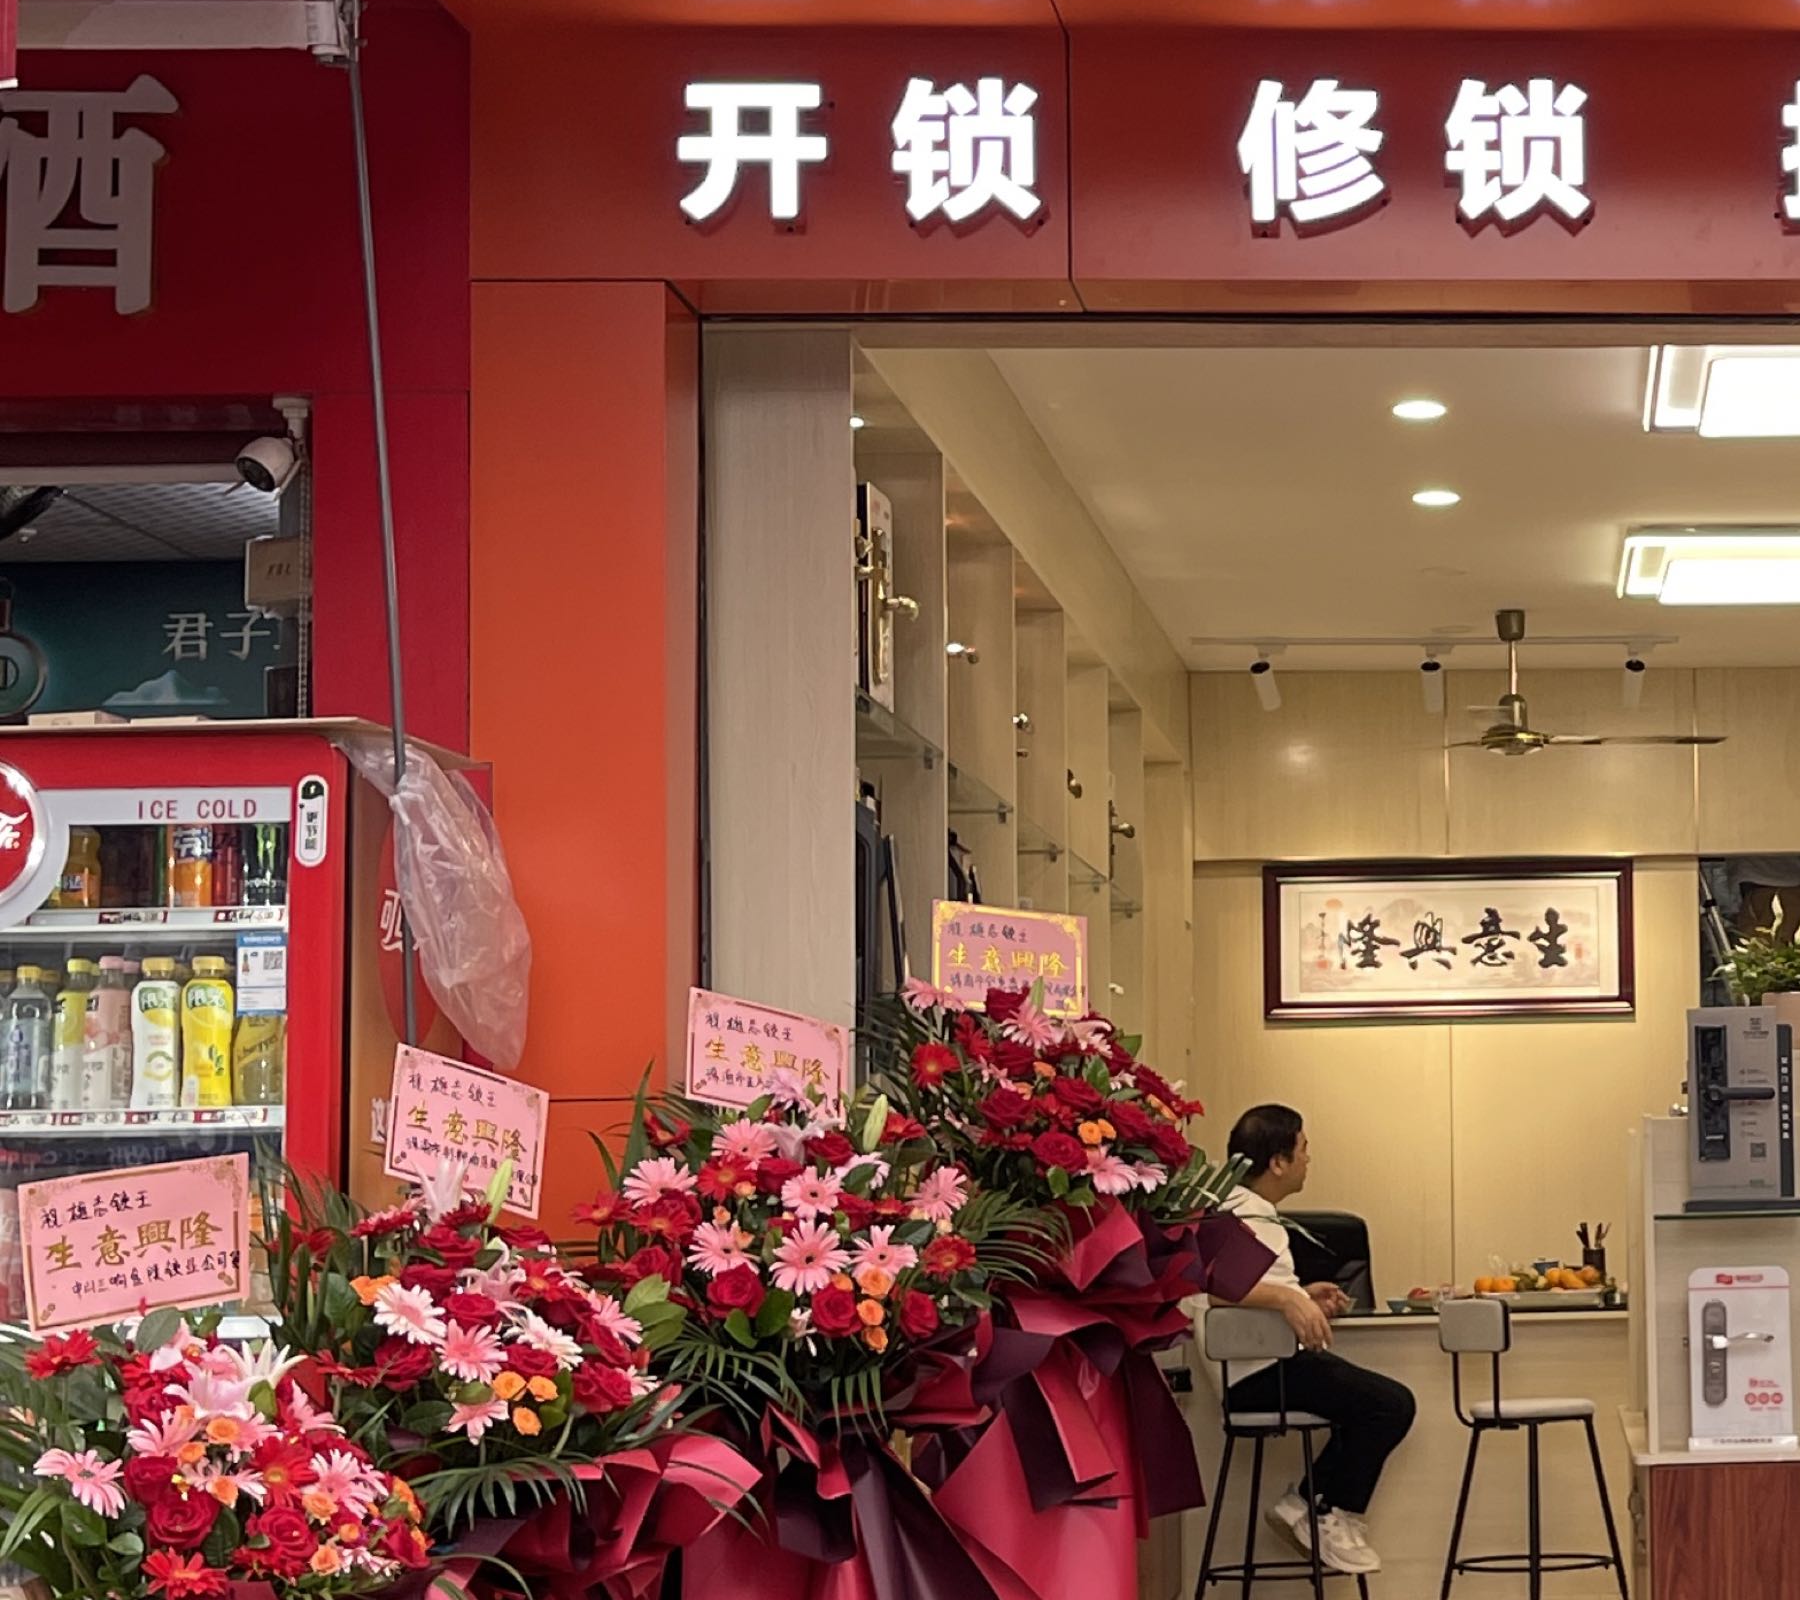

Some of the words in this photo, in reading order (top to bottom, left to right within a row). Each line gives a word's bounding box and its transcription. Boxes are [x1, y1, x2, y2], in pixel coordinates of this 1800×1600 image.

[678, 77, 1042, 224] 开锁
[1236, 76, 1592, 224] 修锁
[162, 612, 283, 662] 君子
[136, 800, 179, 819] ICE
[196, 799, 257, 818] COLD
[406, 1099, 527, 1163] 生意興隆
[44, 1211, 223, 1274] 生意興隆
